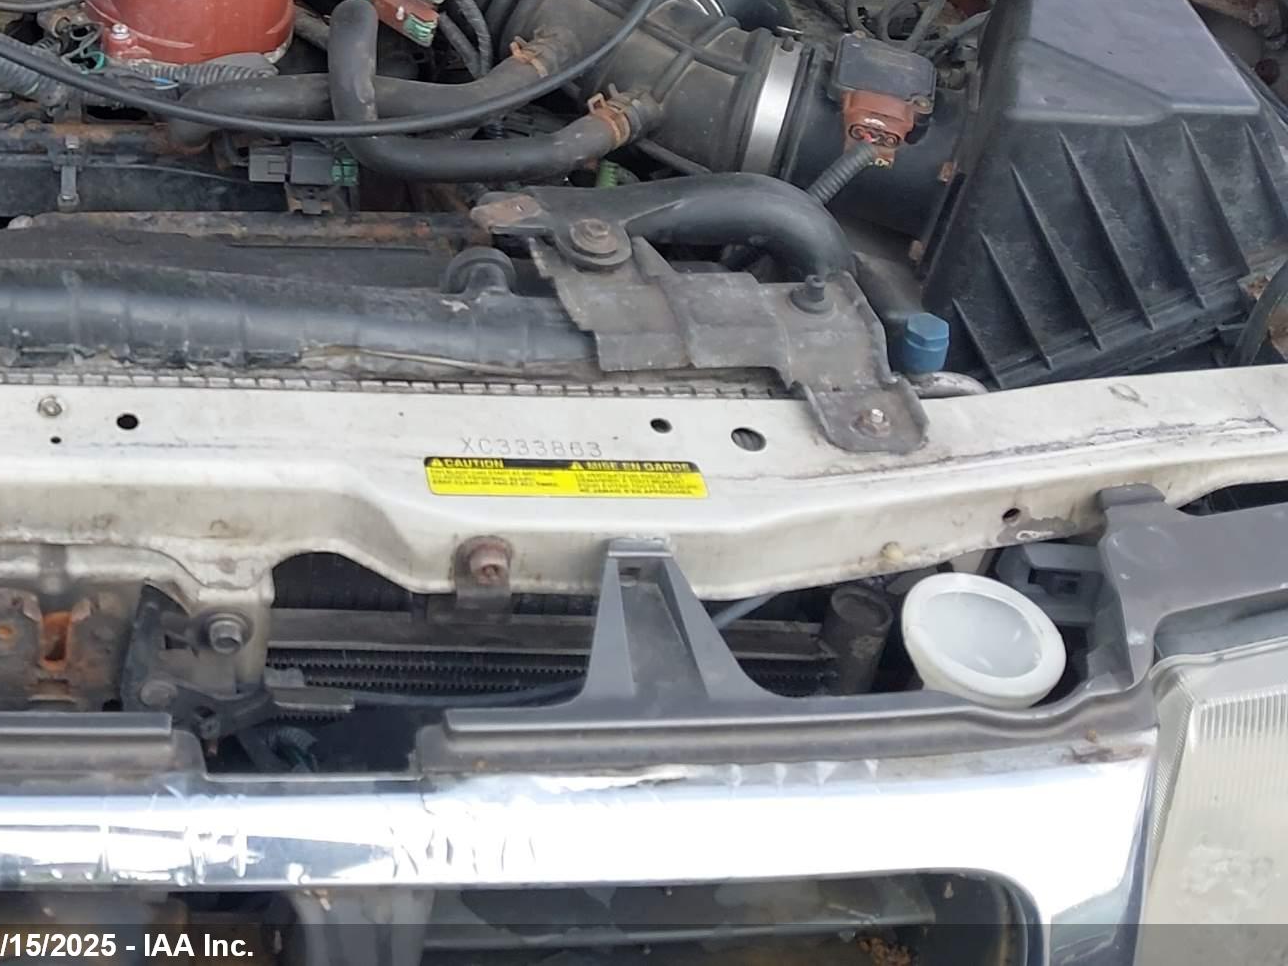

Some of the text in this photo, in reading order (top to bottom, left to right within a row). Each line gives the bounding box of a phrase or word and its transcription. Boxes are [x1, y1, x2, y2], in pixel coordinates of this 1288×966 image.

[443, 458, 504, 469] CAUTION
[586, 461, 692, 472] MISE EN GARDE
